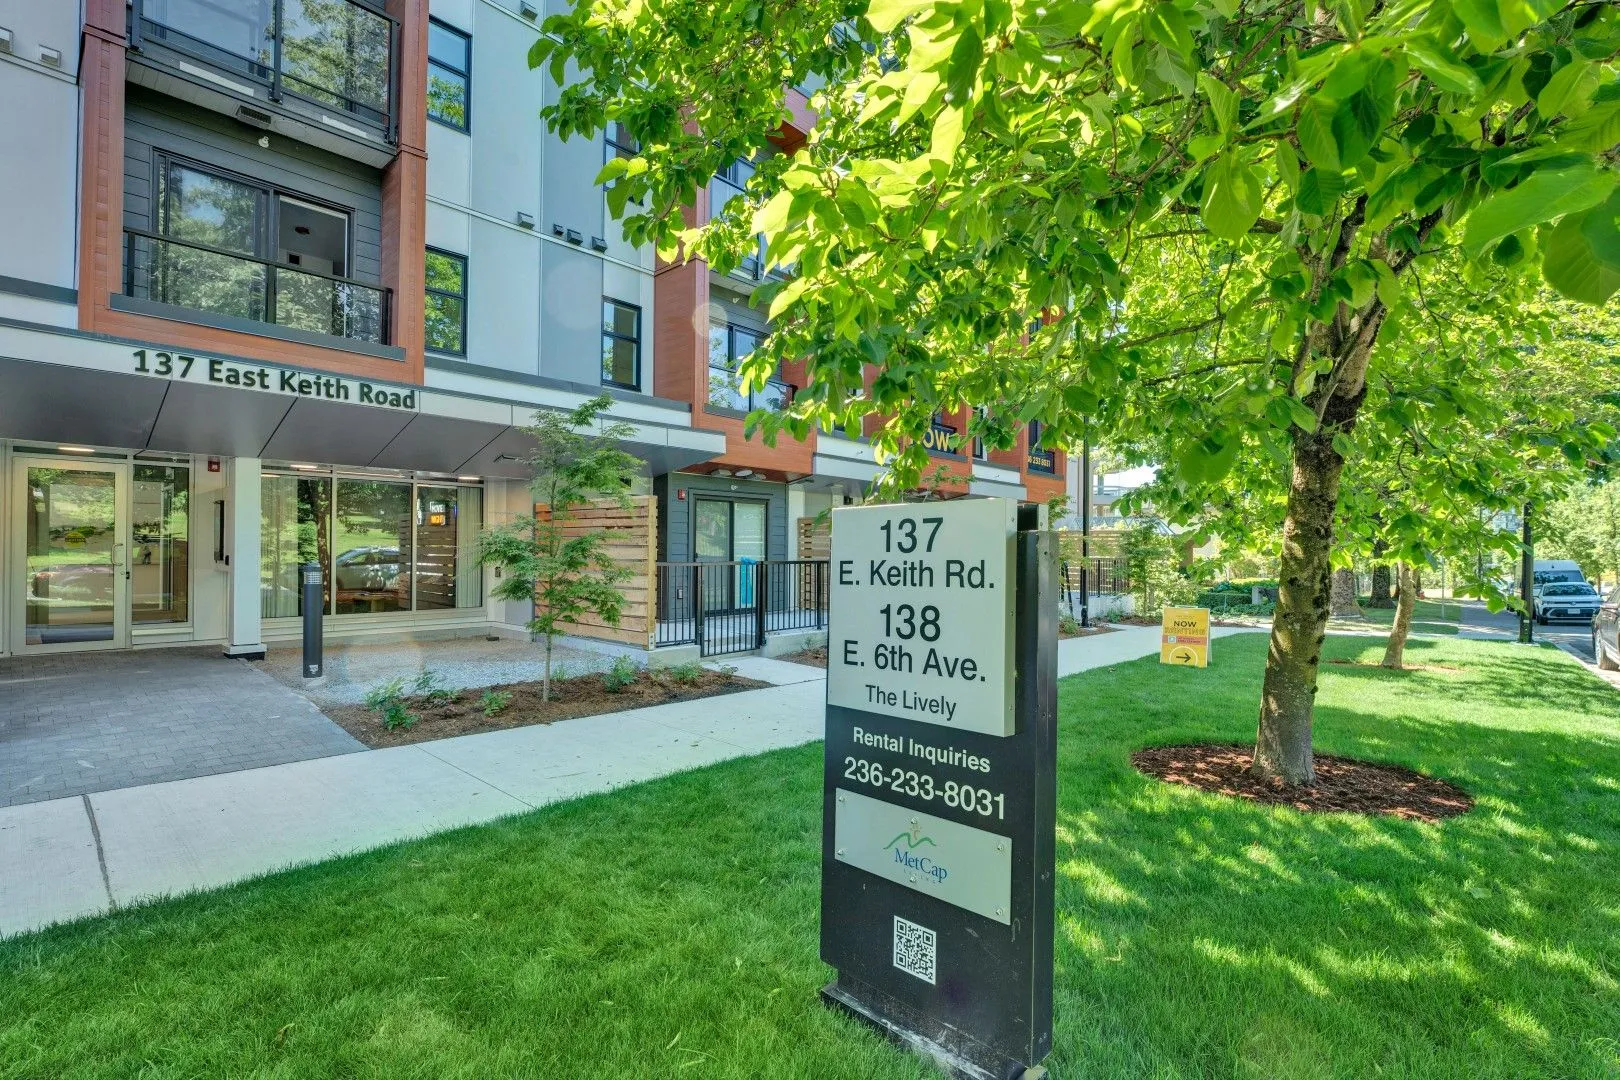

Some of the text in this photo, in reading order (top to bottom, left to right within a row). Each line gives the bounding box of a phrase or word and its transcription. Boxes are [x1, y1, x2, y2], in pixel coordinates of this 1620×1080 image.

[132, 349, 416, 410] 137 East Keith Road
[921, 427, 950, 452] OW
[880, 517, 944, 553] 137
[839, 559, 995, 589] E. Keith Rd.
[879, 603, 941, 642] 138
[1173, 620, 1197, 628] NOW
[843, 639, 986, 682] E. 6th Ave.
[865, 684, 957, 721] The Lively
[853, 726, 991, 773] Rental Inquiries
[844, 756, 1005, 820] 236-233-8031
[894, 847, 948, 884] MetCap
